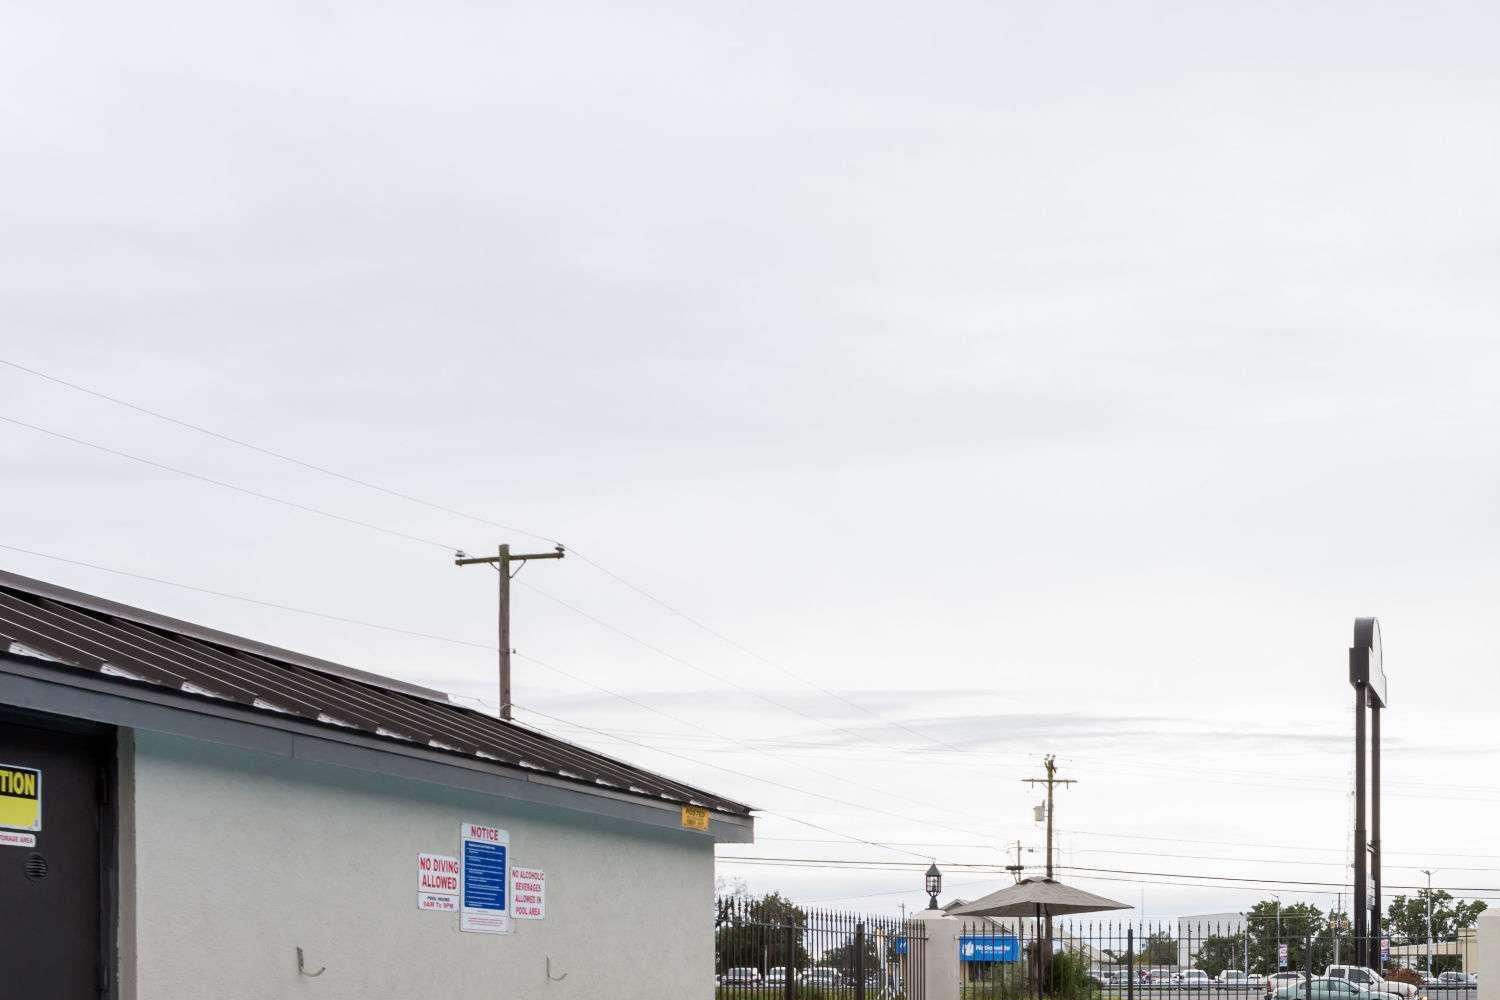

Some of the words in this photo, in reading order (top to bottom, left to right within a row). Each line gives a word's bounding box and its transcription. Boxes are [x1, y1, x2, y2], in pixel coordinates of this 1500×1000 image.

[471, 825, 498, 841] NOTICE
[420, 857, 431, 870] NO
[433, 859, 459, 874] DIVING
[512, 869, 520, 878] NO
[520, 870, 544, 881] ALCOHOLIC
[422, 874, 457, 890] ALLOWED
[515, 882, 542, 892] BEVERAGES
[515, 894, 536, 904] ALLOWED
[515, 906, 528, 915] POOL
[529, 907, 541, 916] AREA
